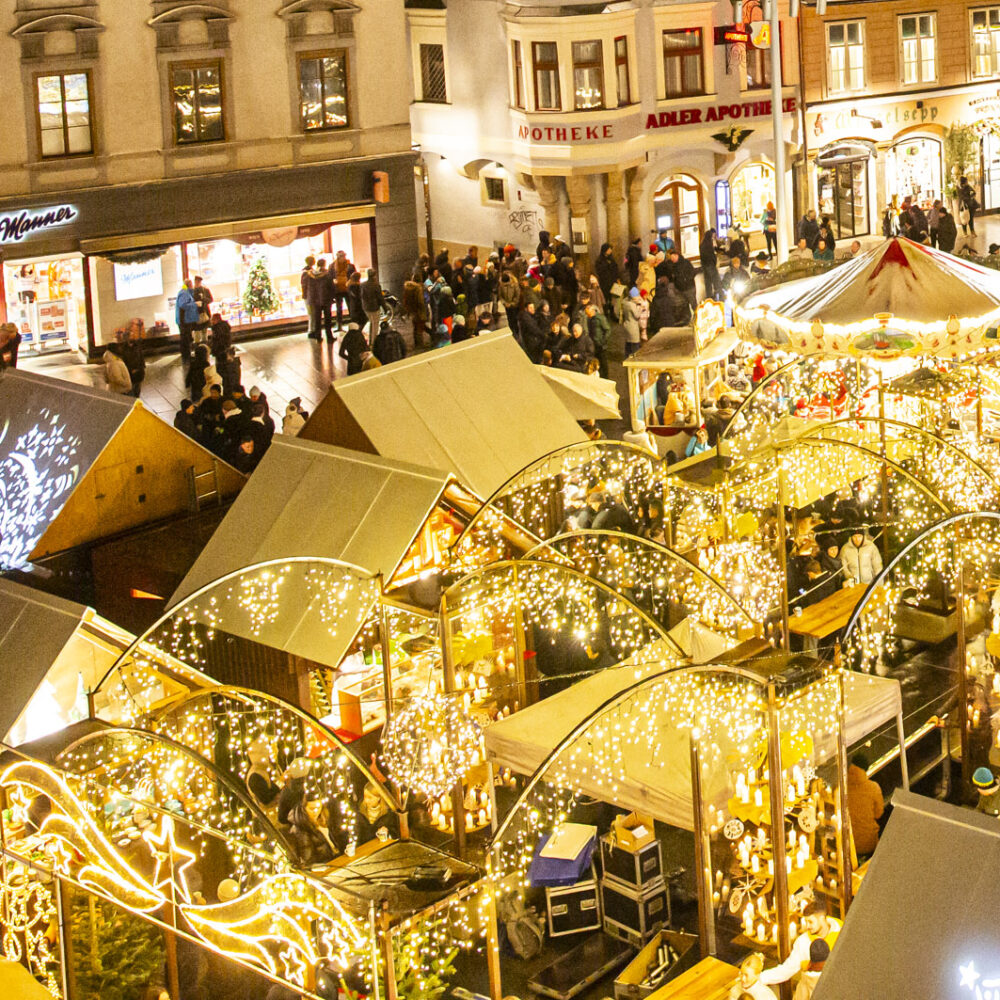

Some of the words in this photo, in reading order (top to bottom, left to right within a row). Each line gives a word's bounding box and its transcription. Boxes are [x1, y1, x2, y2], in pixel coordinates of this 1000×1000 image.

[645, 108, 702, 130] ADLER
[704, 97, 797, 122] APOTHEE
[518, 124, 614, 142] APOTHEKE
[0, 206, 76, 242] Manner
